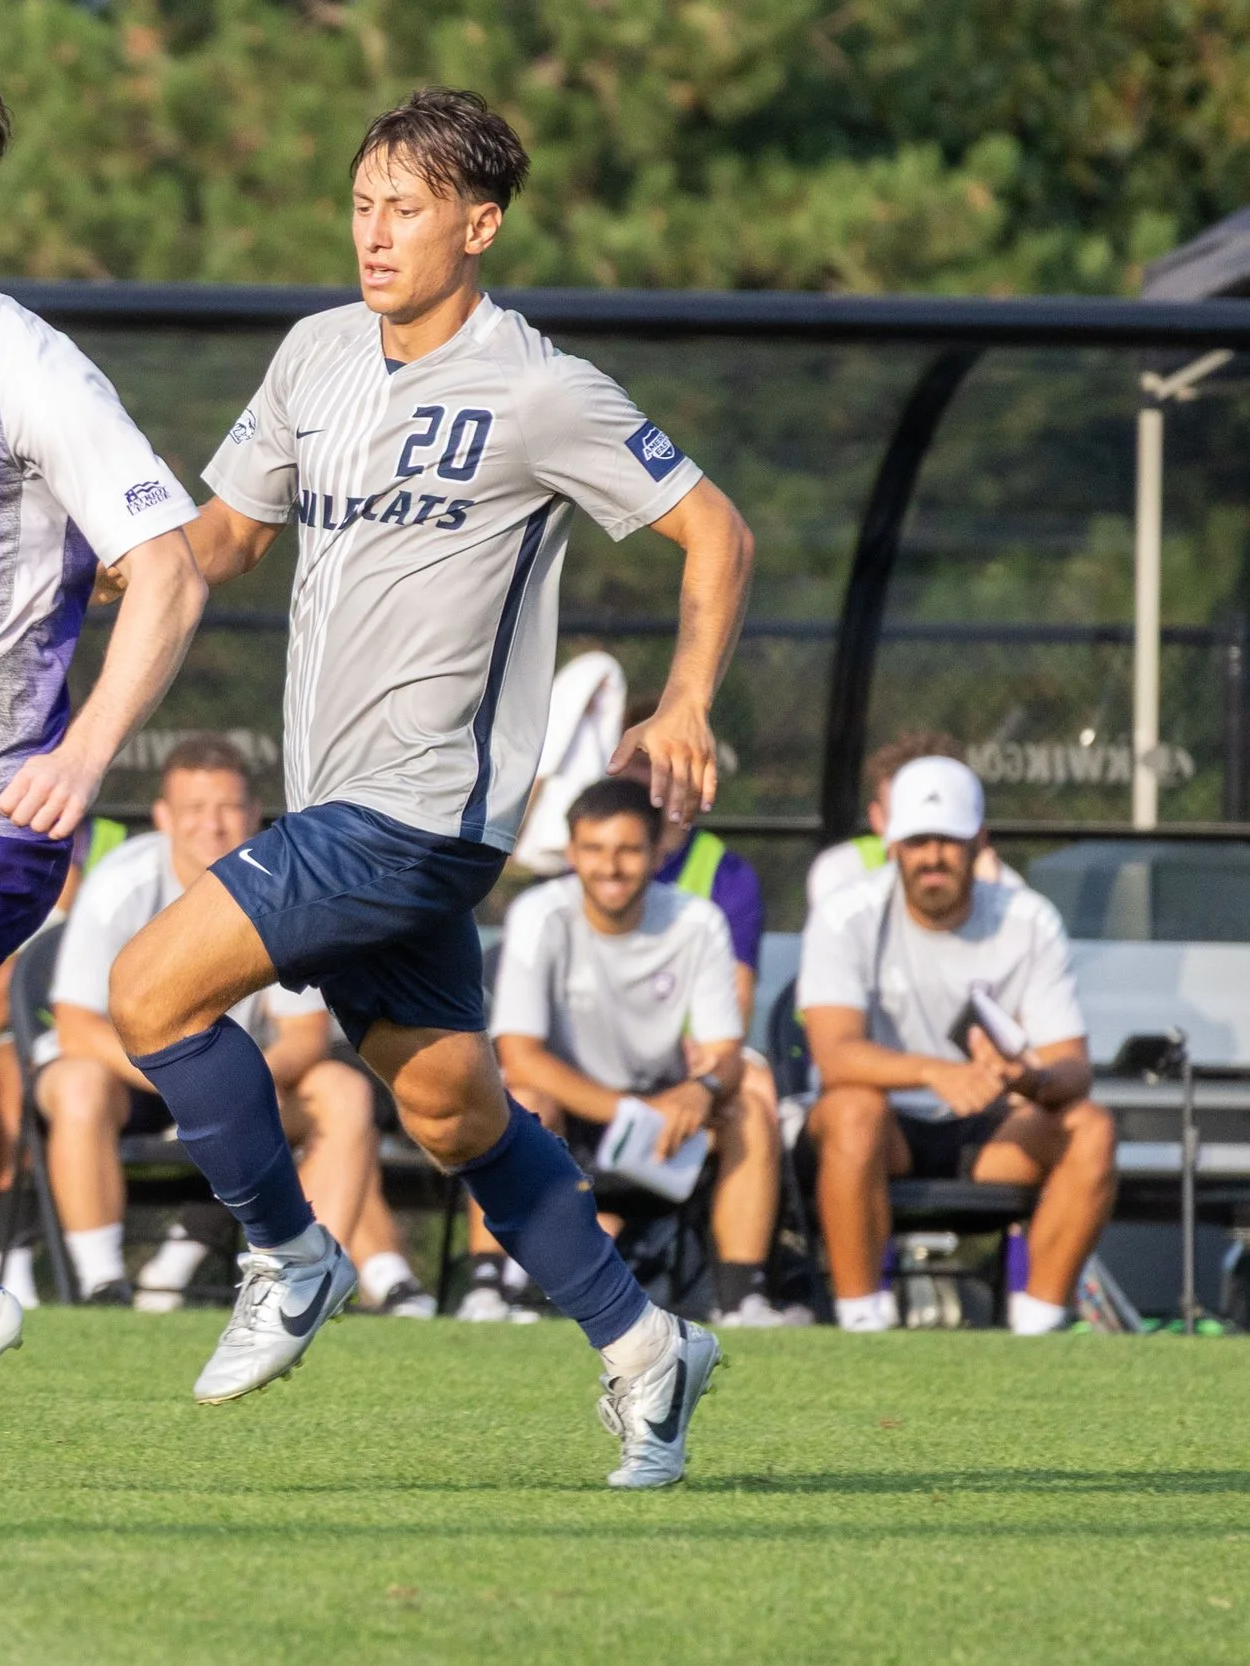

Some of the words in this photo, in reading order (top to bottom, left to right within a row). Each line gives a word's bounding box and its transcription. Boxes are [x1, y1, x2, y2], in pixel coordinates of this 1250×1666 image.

[394, 404, 494, 482] 20
[126, 487, 166, 511] PATRIOT
[129, 492, 171, 516] LEAGUE
